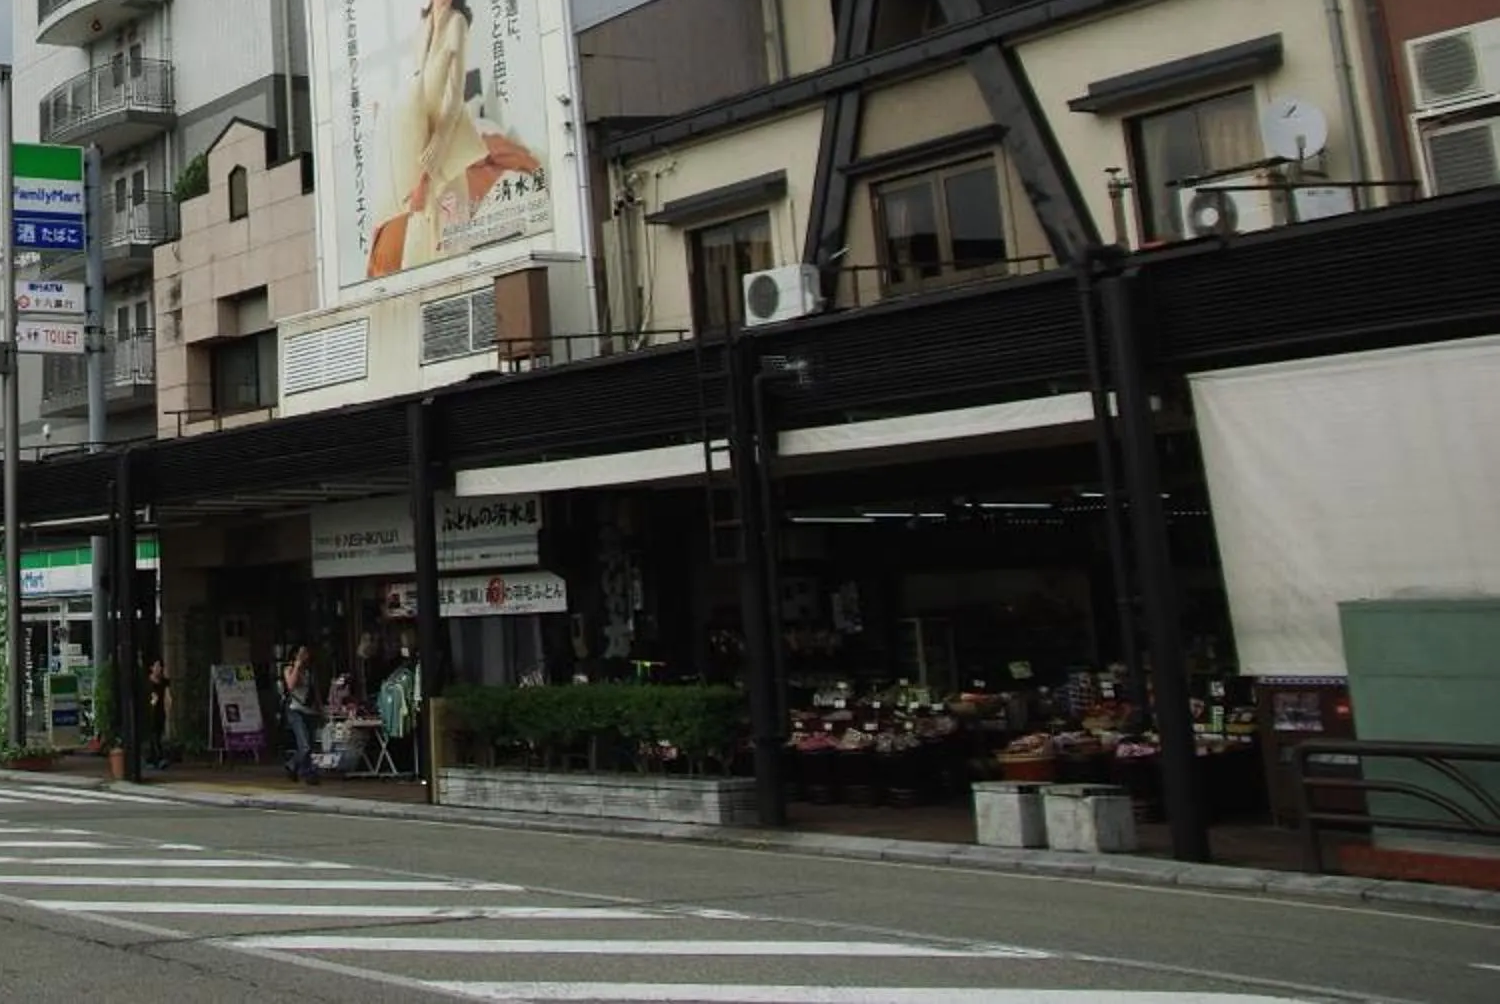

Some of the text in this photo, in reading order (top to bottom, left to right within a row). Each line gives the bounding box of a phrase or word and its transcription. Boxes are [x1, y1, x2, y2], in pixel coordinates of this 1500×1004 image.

[41, 227, 79, 243] たばこ
[42, 328, 78, 345] TOILET
